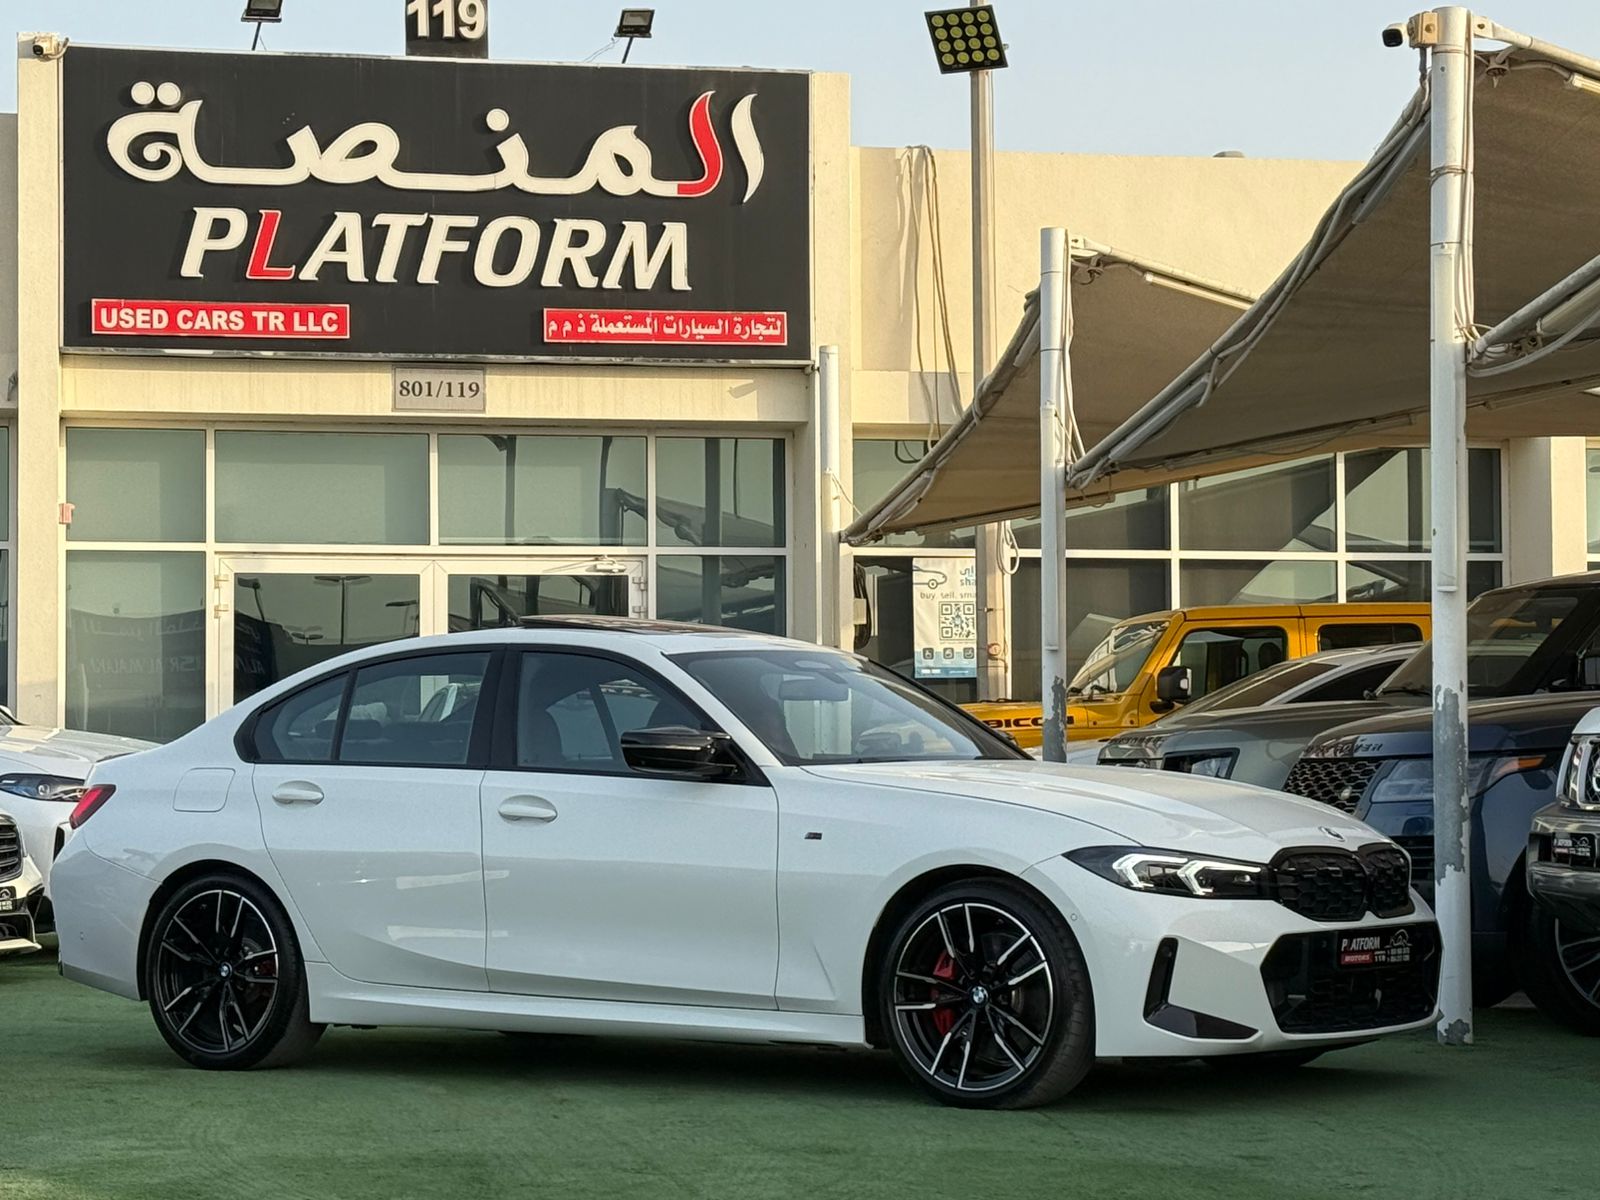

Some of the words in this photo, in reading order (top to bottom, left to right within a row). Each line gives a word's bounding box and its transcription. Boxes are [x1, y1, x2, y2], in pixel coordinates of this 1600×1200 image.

[407, 0, 485, 39] 119
[107, 81, 764, 203] المنصة
[180, 207, 692, 290] PLATFORM
[101, 308, 168, 329] USED
[177, 309, 245, 331] CARS
[252, 311, 285, 332] TR
[293, 312, 338, 332] LLC
[548, 320, 558, 338] م
[563, 320, 572, 338] م
[590, 313, 658, 335] المستعملة
[663, 315, 729, 339] السيارات
[733, 316, 781, 340] لتجارة
[399, 380, 480, 398] 801/119
